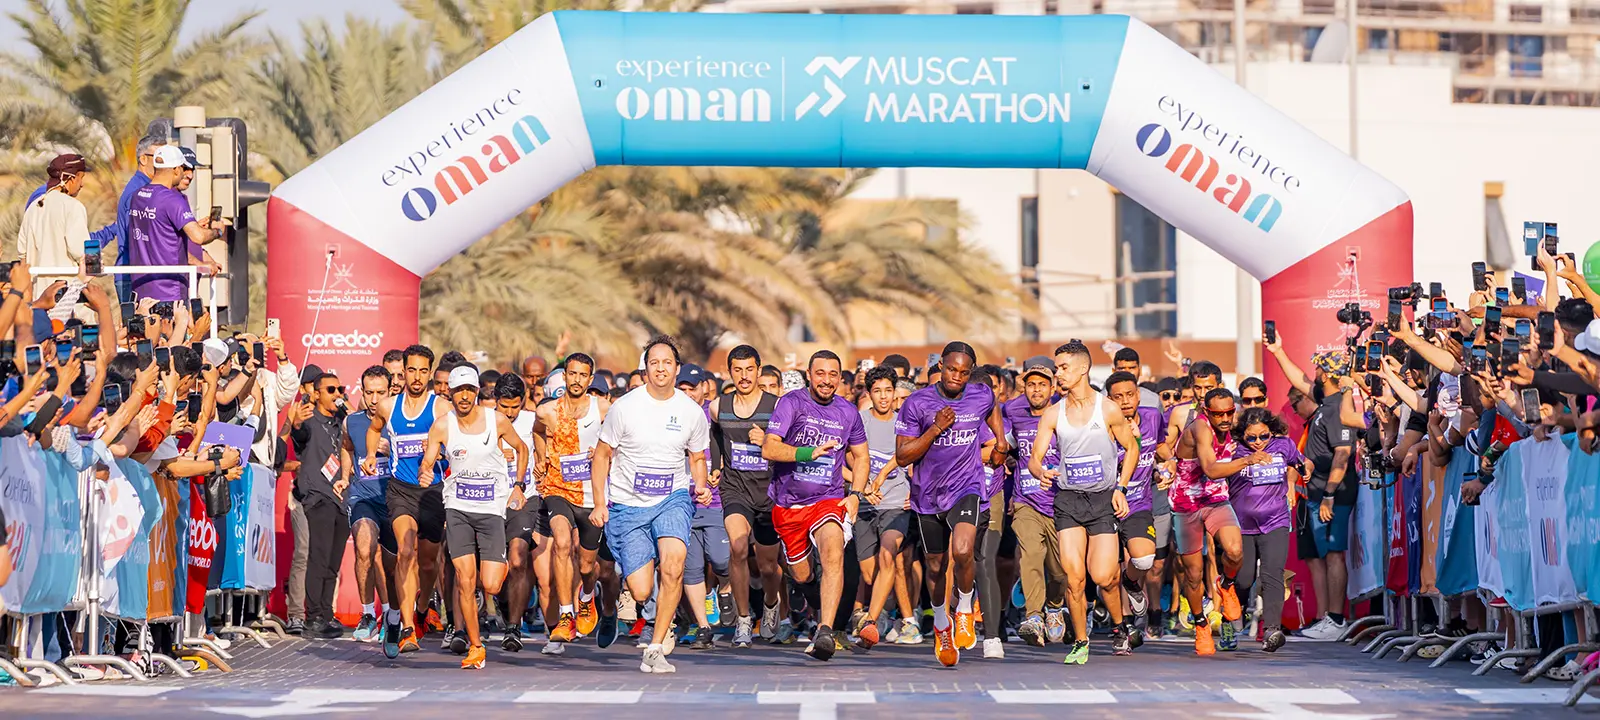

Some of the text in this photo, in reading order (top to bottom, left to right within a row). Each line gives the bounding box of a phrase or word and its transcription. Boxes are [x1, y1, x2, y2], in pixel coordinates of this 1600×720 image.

[615, 55, 771, 83] experience
[864, 56, 1017, 86] MUSCAT
[615, 86, 771, 122] oman
[864, 92, 1071, 123] MARATHON
[381, 88, 523, 187] experience
[1158, 95, 1301, 194] experience
[401, 115, 551, 222] oman
[1136, 123, 1283, 233] oman
[365, 296, 379, 304] وزارة
[301, 329, 382, 348] ooredoo
[570, 463, 590, 474] 3882
[740, 455, 759, 464] 2100
[1072, 466, 1094, 477] 3325
[1261, 467, 1279, 477] 3318
[643, 478, 665, 488] 3258
[464, 488, 486, 498] 3326
[194, 555, 211, 569] WORLD
